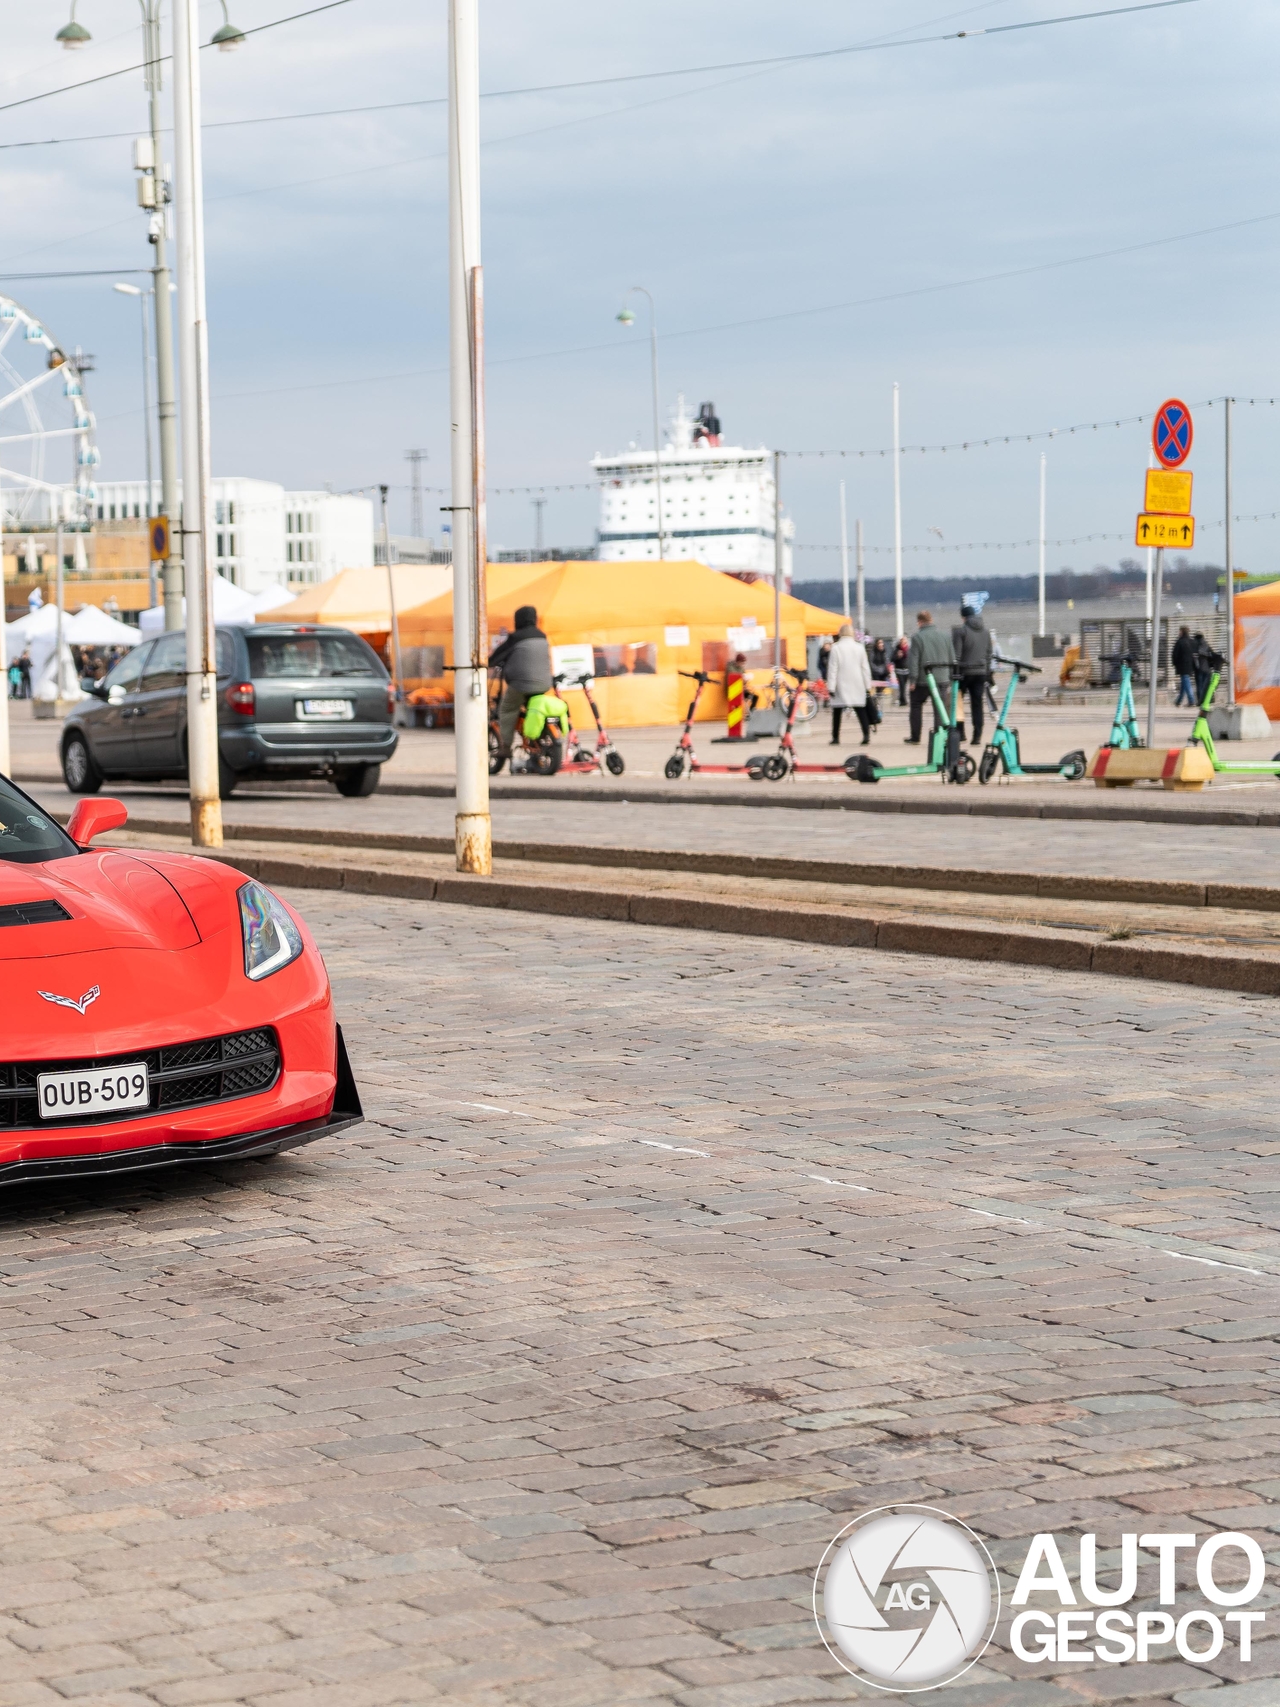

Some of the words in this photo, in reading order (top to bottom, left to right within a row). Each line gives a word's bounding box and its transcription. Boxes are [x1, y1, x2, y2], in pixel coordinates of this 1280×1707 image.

[1154, 523, 1166, 538] 12
[1168, 527, 1178, 537] m
[43, 1074, 145, 1107] OUB-509
